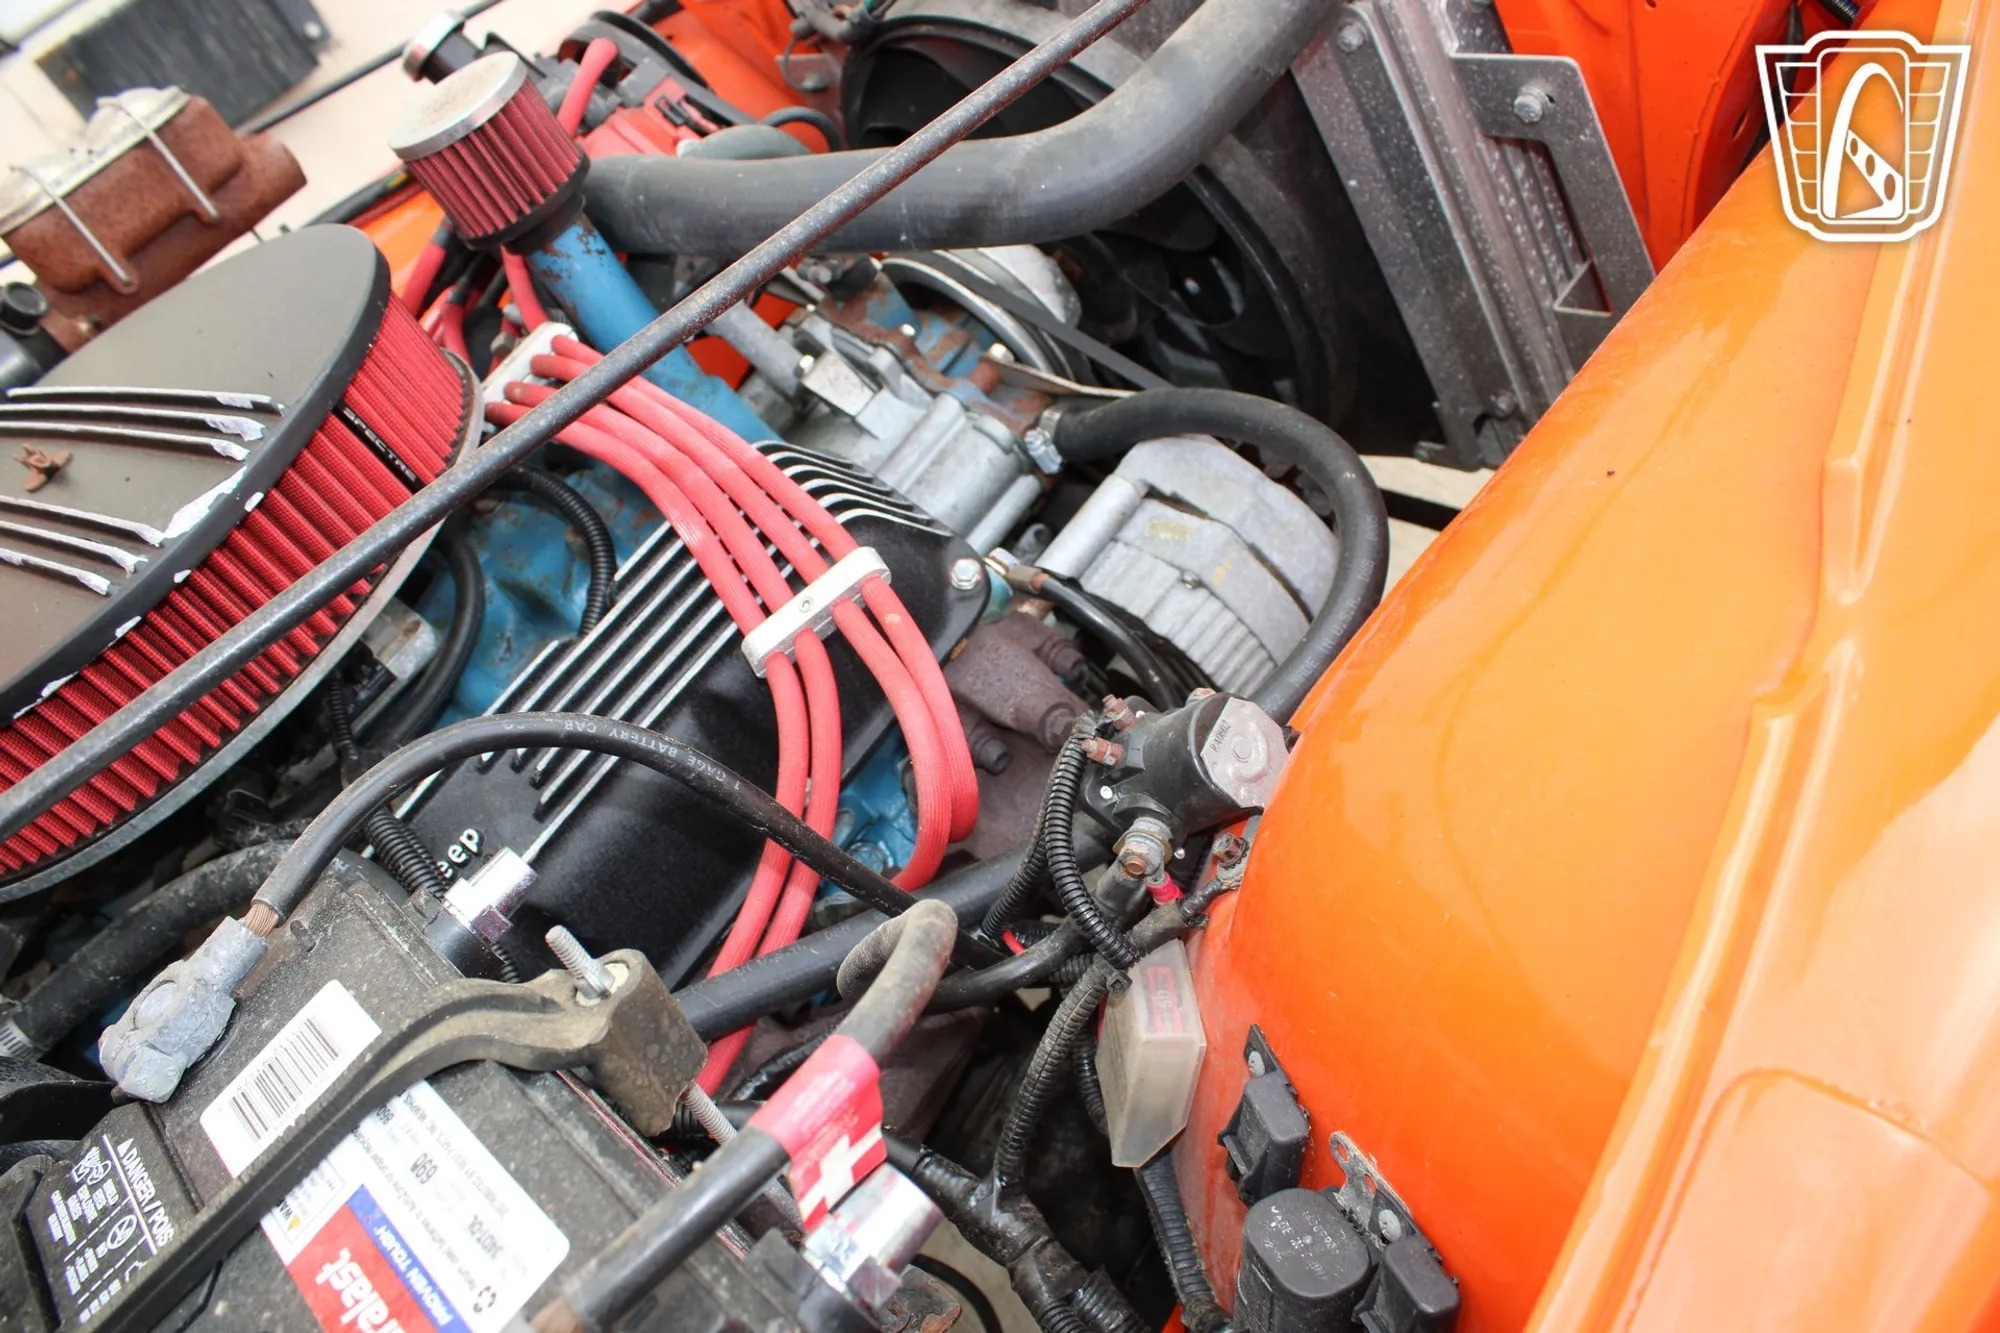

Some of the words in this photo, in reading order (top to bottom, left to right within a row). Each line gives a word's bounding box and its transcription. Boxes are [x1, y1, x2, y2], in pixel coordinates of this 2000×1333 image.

[343, 405, 418, 483] SPECTRE
[1291, 657, 1319, 688] MADE
[607, 727, 679, 757] BATTERY
[685, 753, 728, 780] GAGE
[376, 1104, 395, 1125] 860
[120, 1147, 156, 1208] DANGER
[410, 1153, 438, 1184] 690
[314, 1247, 407, 1333] ralast
[405, 1266, 454, 1326] PROVEN
